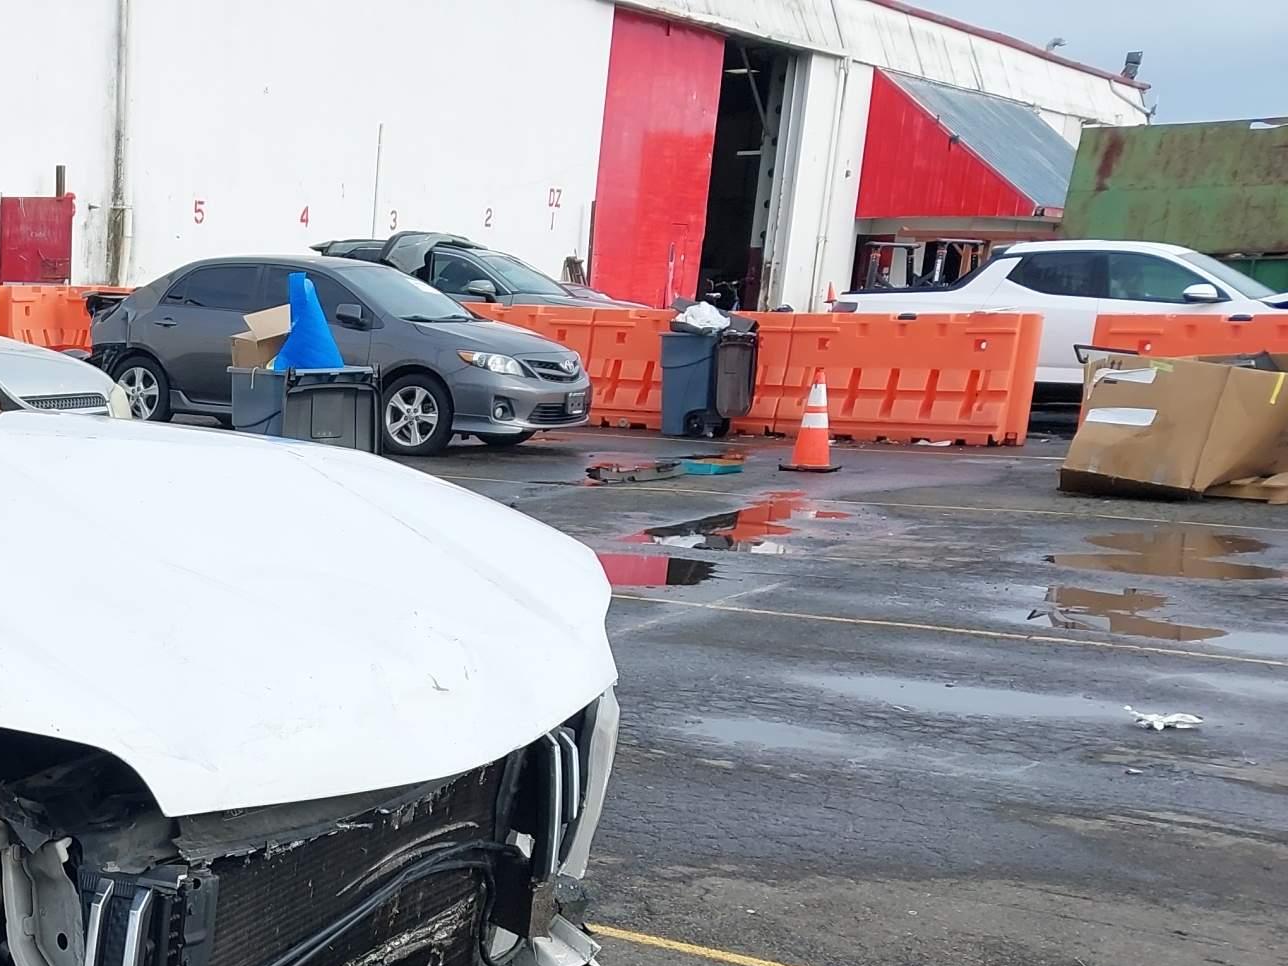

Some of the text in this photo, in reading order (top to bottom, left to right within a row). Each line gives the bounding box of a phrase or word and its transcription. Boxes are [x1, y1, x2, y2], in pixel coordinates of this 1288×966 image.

[194, 199, 205, 224] 5
[300, 205, 309, 228] 4
[390, 210, 398, 230] 3
[484, 208, 492, 227] 2
